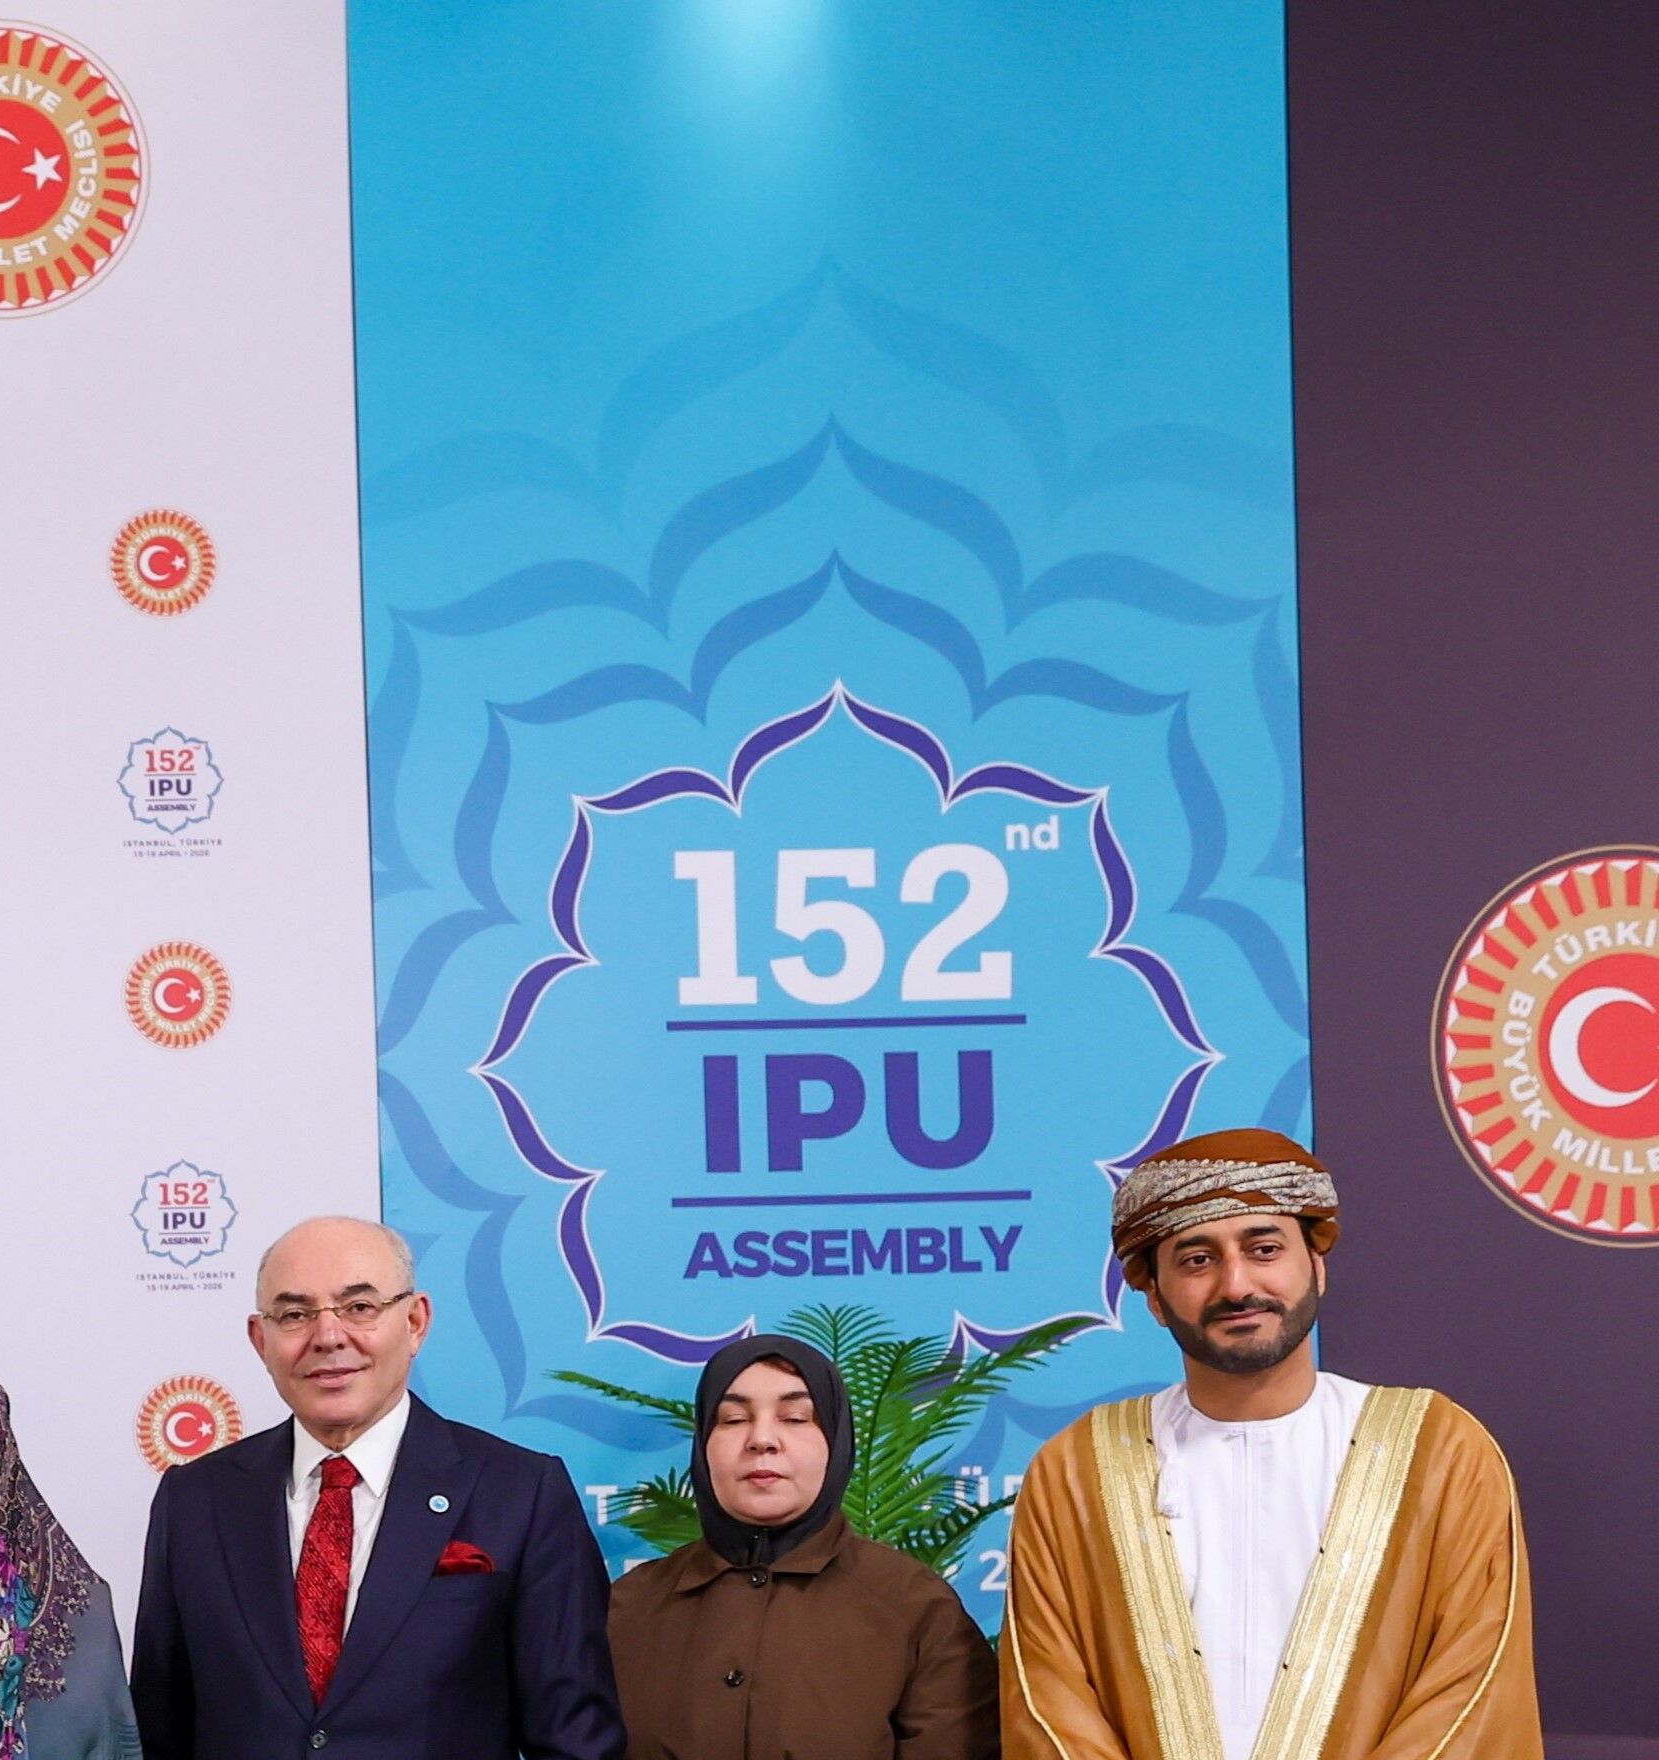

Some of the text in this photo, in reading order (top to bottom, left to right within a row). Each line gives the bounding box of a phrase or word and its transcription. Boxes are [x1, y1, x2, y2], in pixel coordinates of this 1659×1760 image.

[52, 119, 98, 242] MECLİSİ
[144, 750, 196, 775] 152
[149, 779, 192, 796] IPU
[147, 804, 196, 812] ASSEMBLY
[673, 815, 1060, 1006] 152 nd
[1532, 919, 1659, 983] TÜRKİ
[1501, 990, 1659, 1175] BÜYÜK MİLLE
[702, 1049, 996, 1174] IPU
[158, 1183, 210, 1208] 152
[163, 1212, 205, 1230] IPU
[160, 1237, 209, 1245] ASSEMBLY
[683, 1225, 1024, 1279] ASSEMBLY
